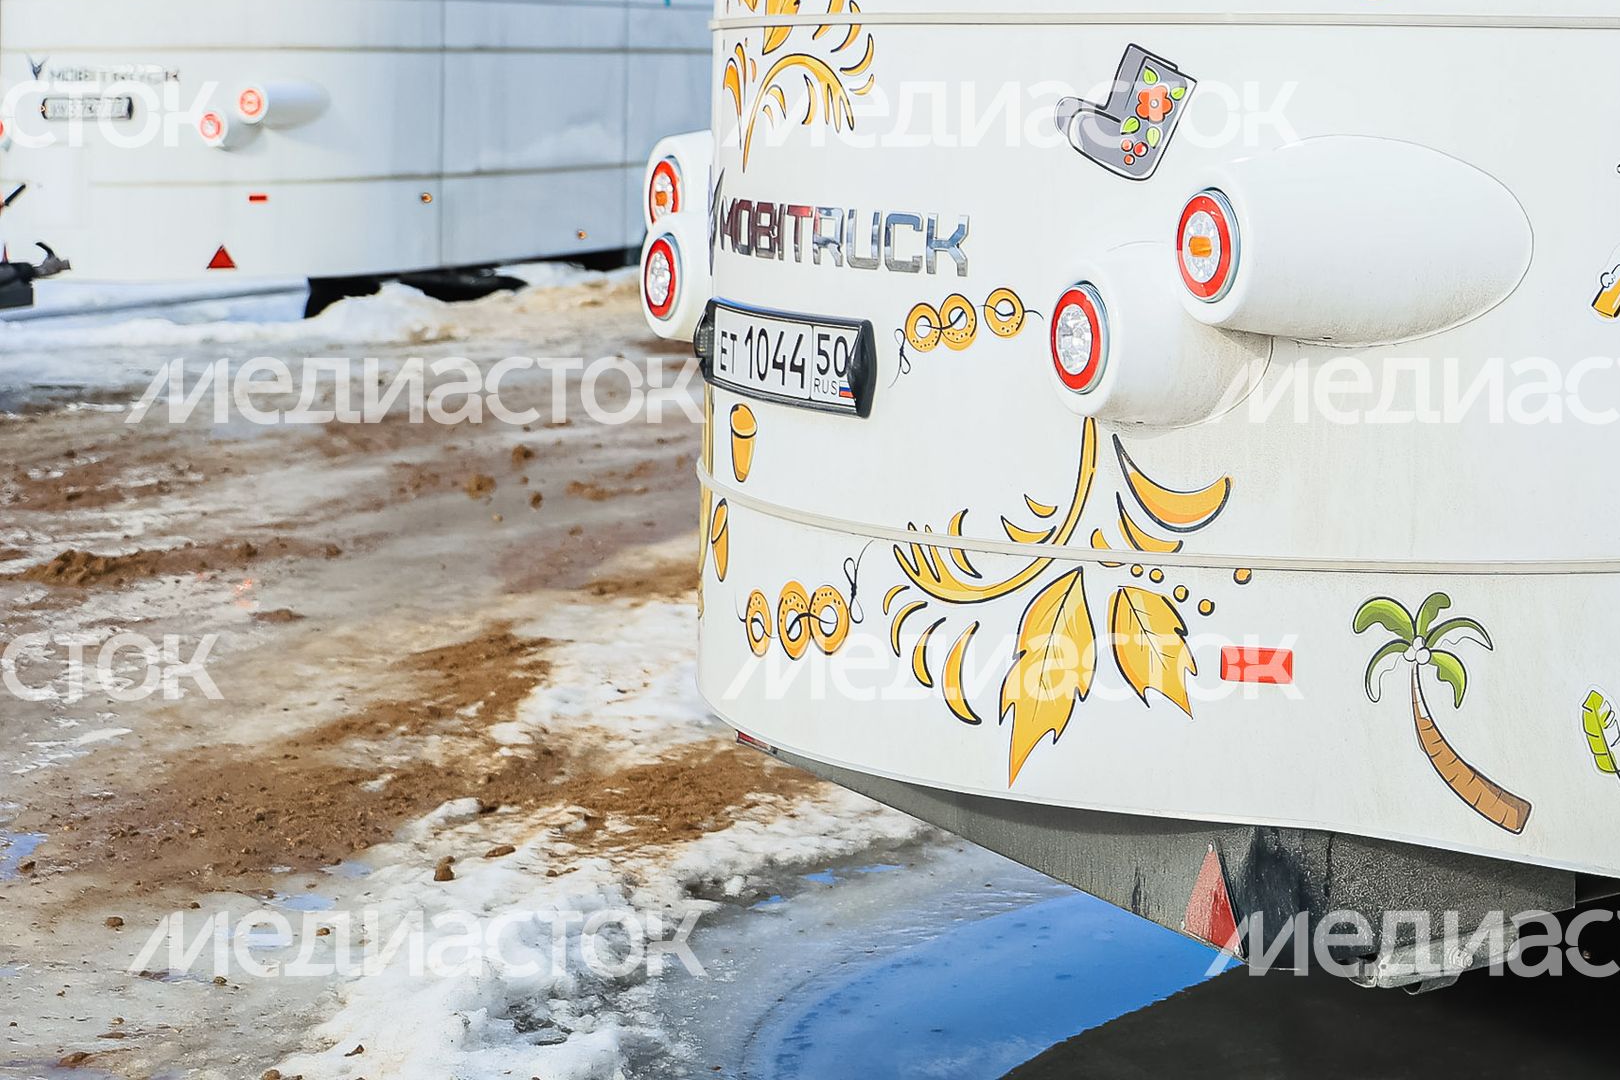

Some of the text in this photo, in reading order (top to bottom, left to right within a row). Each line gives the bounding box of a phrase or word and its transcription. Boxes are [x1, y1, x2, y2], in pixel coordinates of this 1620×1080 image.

[719, 195, 970, 277] MOBITRUCK
[744, 325, 806, 389] 1044
[815, 334, 848, 377] 50
[813, 377, 838, 396] RUS
